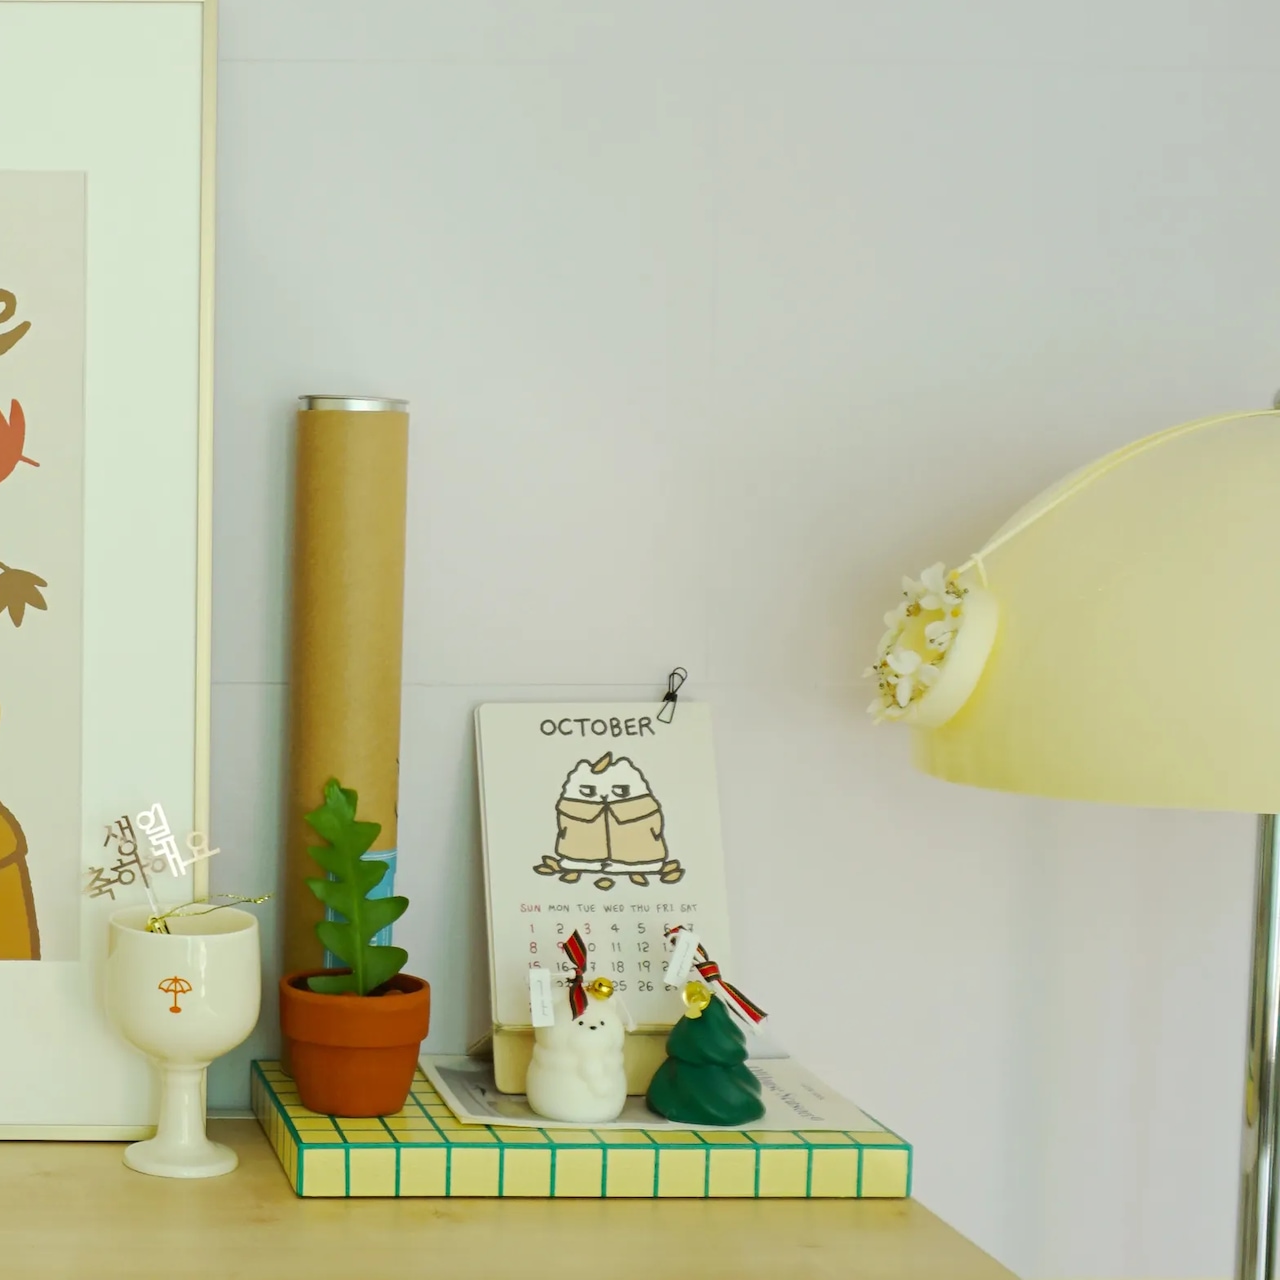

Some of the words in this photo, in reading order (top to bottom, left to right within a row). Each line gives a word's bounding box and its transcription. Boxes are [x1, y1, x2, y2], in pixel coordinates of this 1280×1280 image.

[540, 717, 656, 737] OCTOBER
[520, 903, 542, 913] SUN
[548, 903, 570, 913] MON
[576, 903, 596, 913] TUE
[603, 903, 625, 913] WED
[630, 903, 650, 913] THU
[656, 903, 674, 913] FRI
[680, 903, 698, 913] SAT
[530, 923, 535, 933] 1
[556, 923, 564, 934] 2
[584, 923, 591, 934] 3
[610, 923, 620, 933] 4
[638, 923, 646, 934] 5
[529, 942, 538, 954] 8
[556, 942, 565, 952] 9
[611, 942, 622, 952] 11
[637, 941, 650, 953] 12
[556, 961, 569, 972] 16
[611, 961, 624, 973] 18
[637, 961, 651, 973] 19
[638, 981, 654, 992] 26
